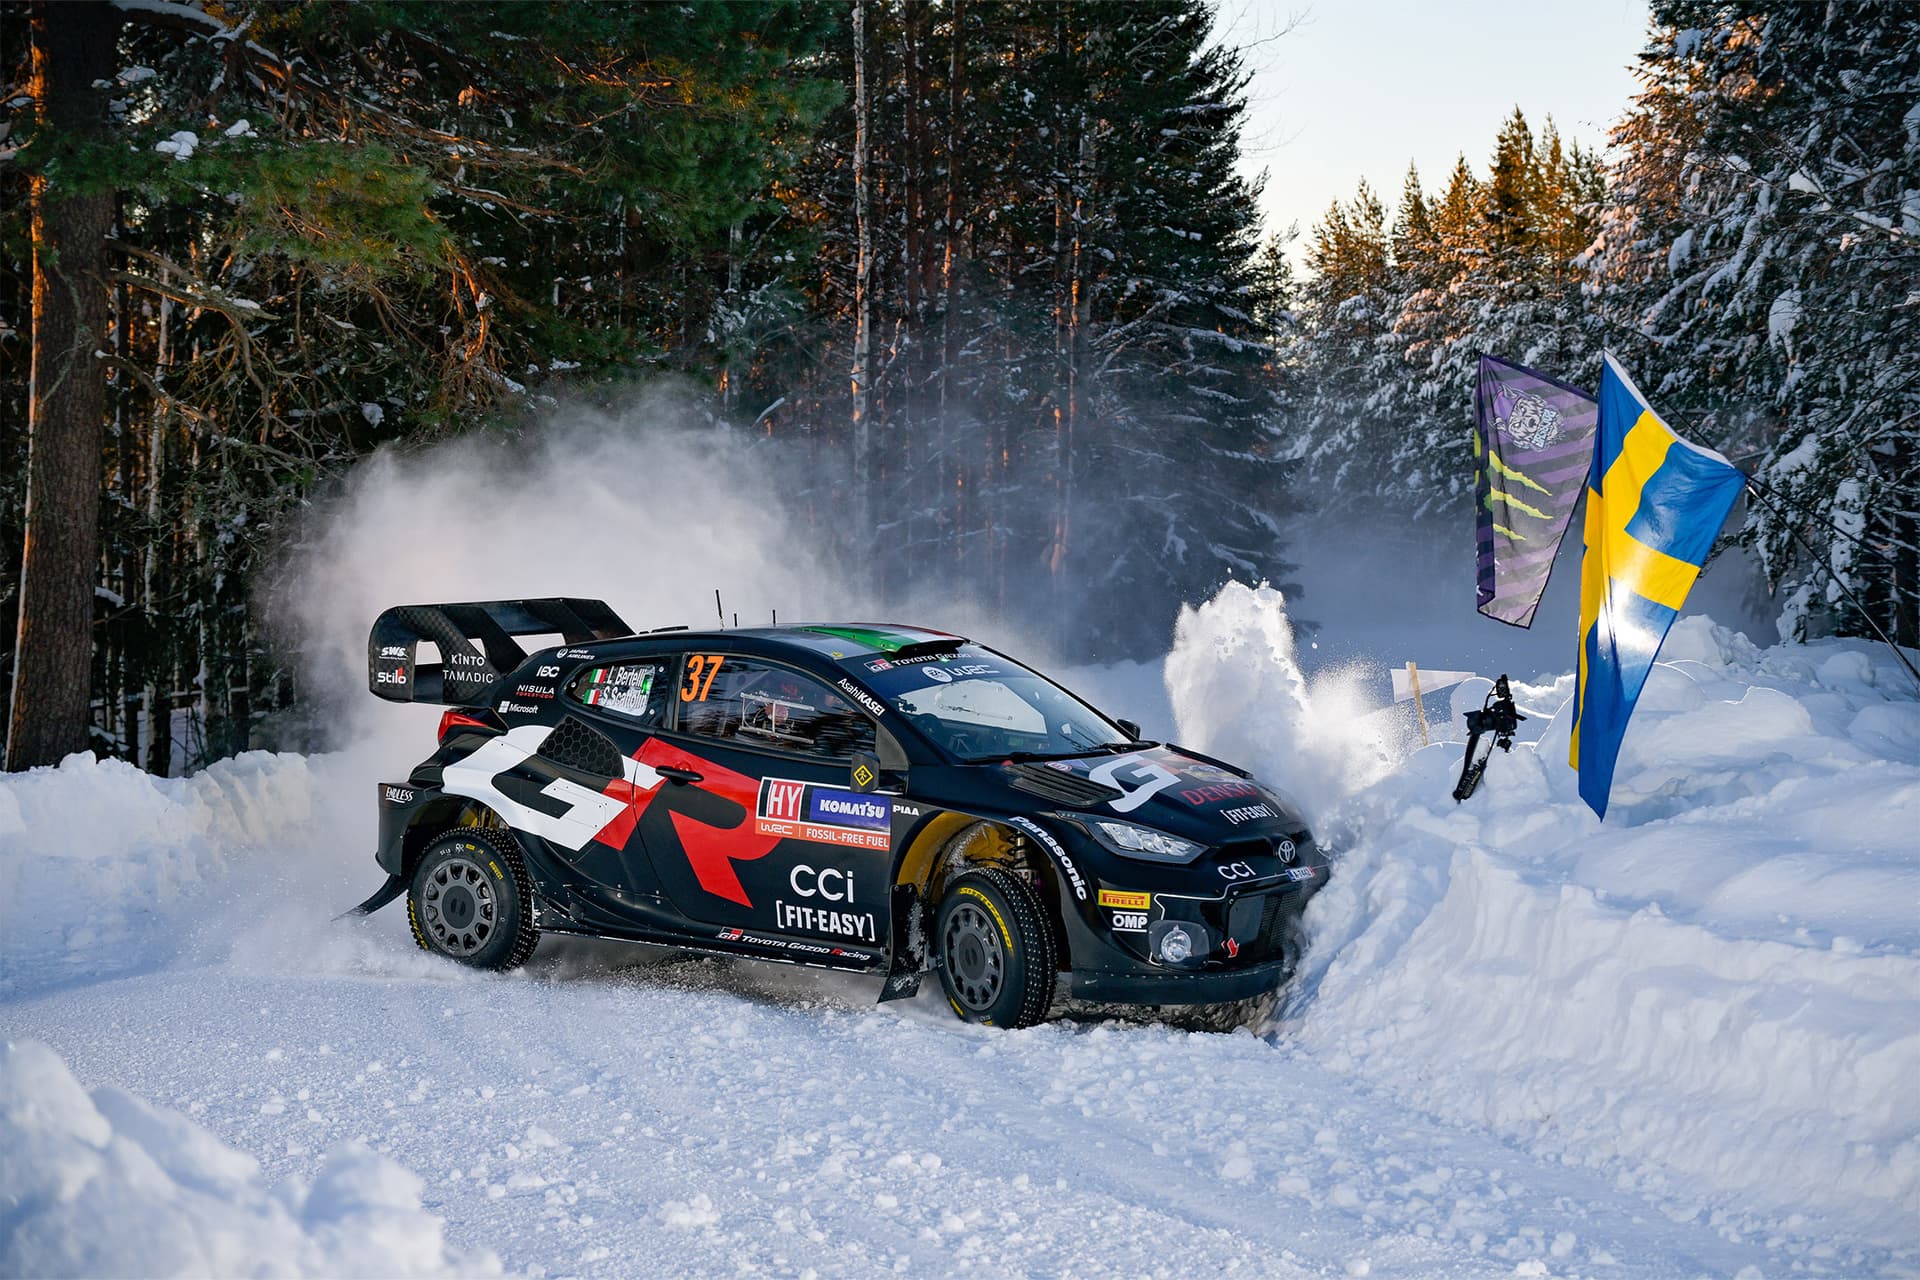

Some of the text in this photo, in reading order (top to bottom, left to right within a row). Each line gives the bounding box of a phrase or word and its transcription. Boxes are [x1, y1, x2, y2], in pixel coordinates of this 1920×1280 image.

[891, 655, 935, 667] TOYOTA
[377, 669, 407, 685] Stilo
[442, 670, 494, 683] TAMADIC
[615, 666, 647, 689] Bertelli
[680, 655, 725, 702] 37
[517, 684, 555, 695] NISULA
[509, 703, 539, 713] Microsoft
[768, 784, 801, 817] HY
[1179, 780, 1258, 805] DENSO
[819, 799, 886, 819] KOMATSU
[892, 804, 920, 817] PIAA
[806, 828, 889, 849] FOSSIL-FREE FUEL
[1008, 816, 1087, 901] Panasonic
[1102, 893, 1145, 906] PIRELLI
[1112, 914, 1148, 929] OMP
[742, 935, 787, 948] TOYOTA
[787, 942, 831, 954] GAZOO
[831, 948, 872, 961] Racing
